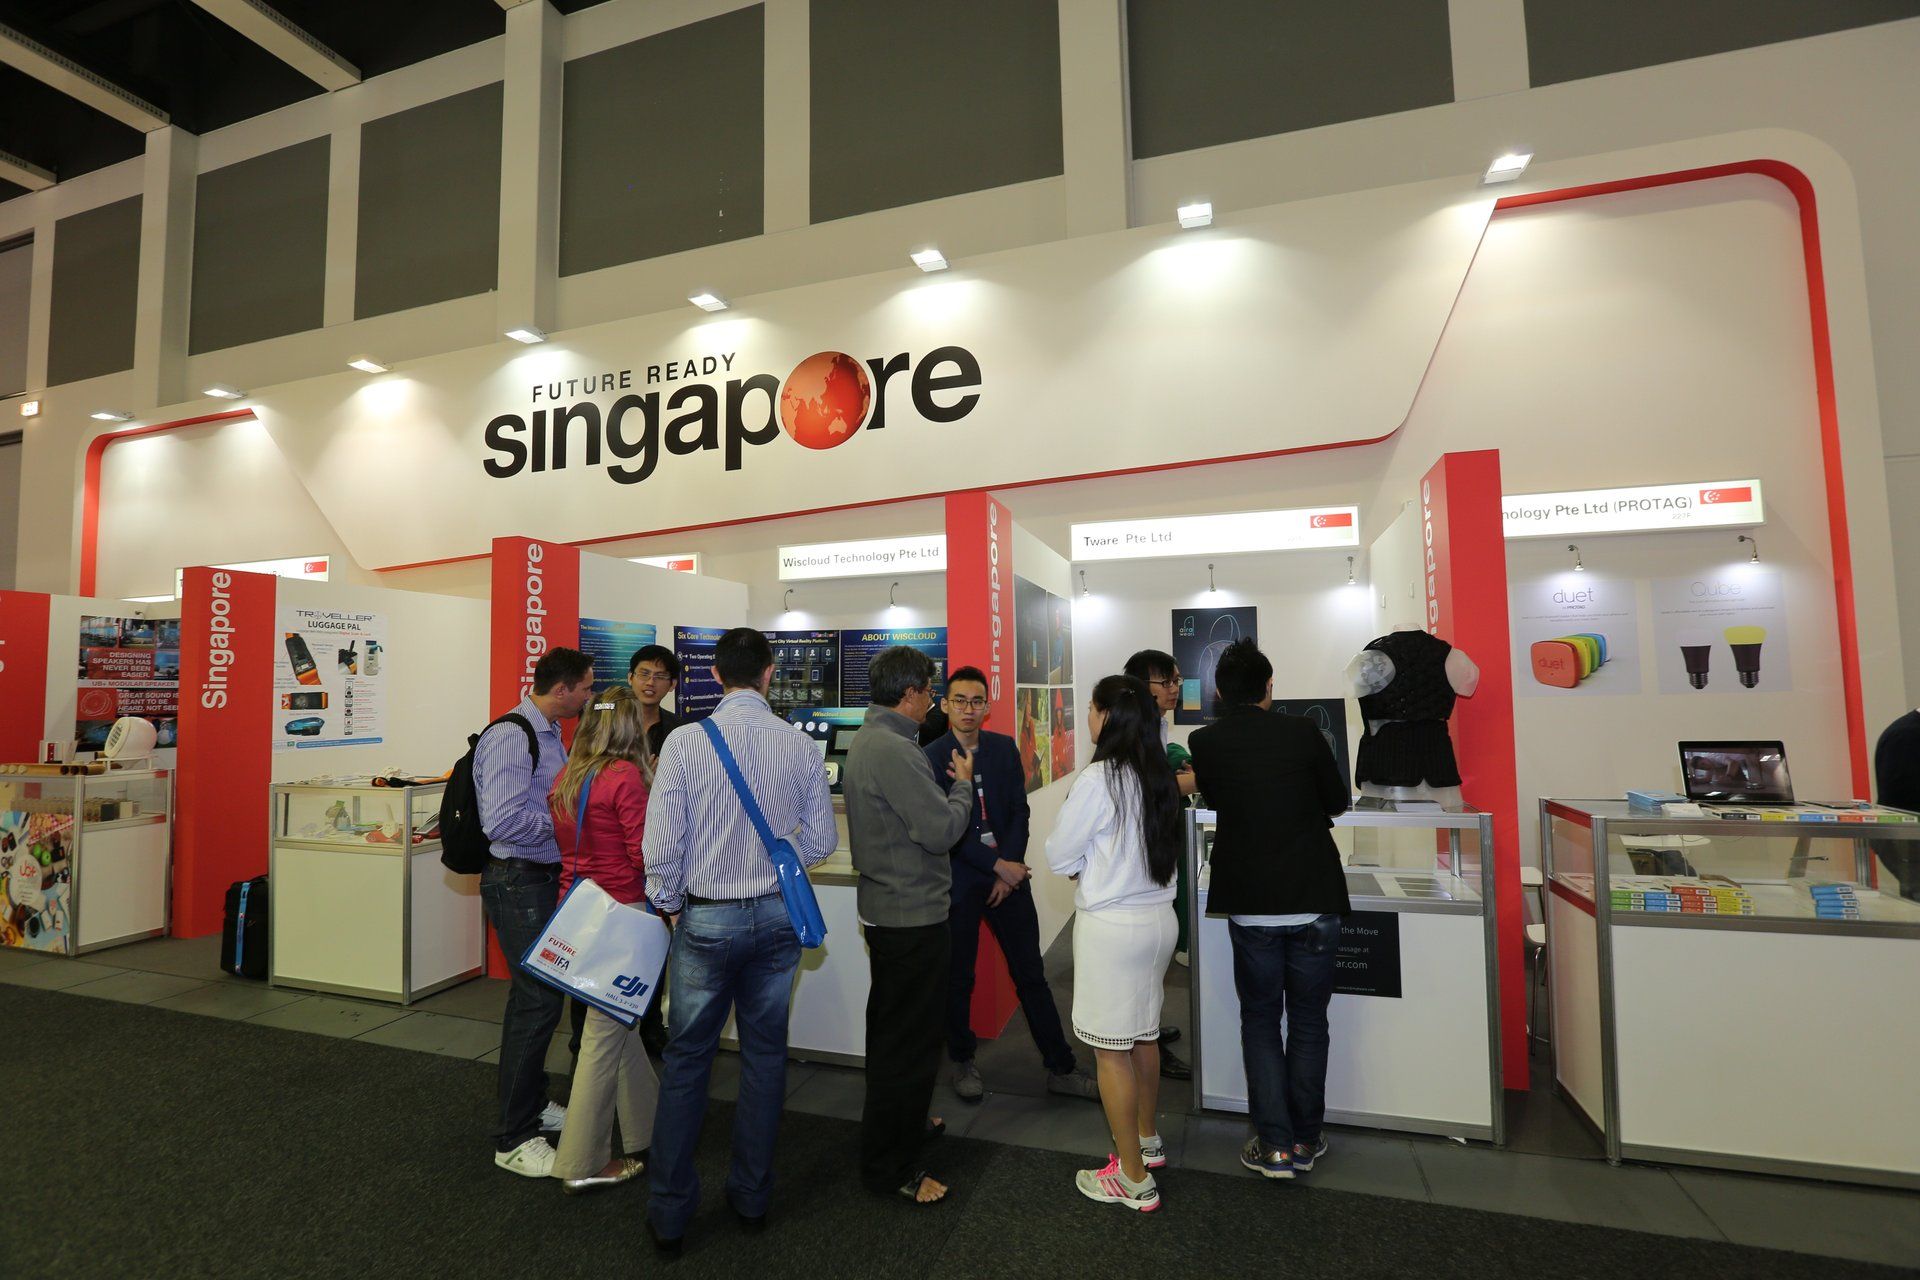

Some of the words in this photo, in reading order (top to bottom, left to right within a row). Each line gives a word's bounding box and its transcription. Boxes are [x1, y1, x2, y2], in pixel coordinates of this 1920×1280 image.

[532, 369, 632, 403] FUTURE
[647, 351, 736, 386] READY
[1555, 504, 1579, 516] Pte
[1584, 502, 1608, 515] Ltd
[1613, 495, 1693, 513] (PROTAG)
[1084, 535, 1119, 547] Tware
[1126, 533, 1147, 544] Pte
[1151, 531, 1172, 543] Ltd
[783, 555, 830, 567] Wiscloud
[834, 551, 895, 564] Technology
[899, 549, 917, 559] Pte
[921, 547, 939, 557] Ltd
[1423, 479, 1439, 635] gapore
[1552, 587, 1594, 604] duet
[1690, 581, 1742, 597] Qube
[308, 621, 345, 630] LUGGAGE
[347, 623, 361, 631] PAL
[201, 571, 235, 709] Singapore
[862, 633, 890, 641] ABOUT
[892, 632, 937, 640] WISCLOUD
[1538, 657, 1566, 671] duet
[1341, 926, 1355, 935] the
[1356, 927, 1379, 936] Move
[548, 937, 577, 957] FUTURE
[554, 955, 570, 971] IFA
